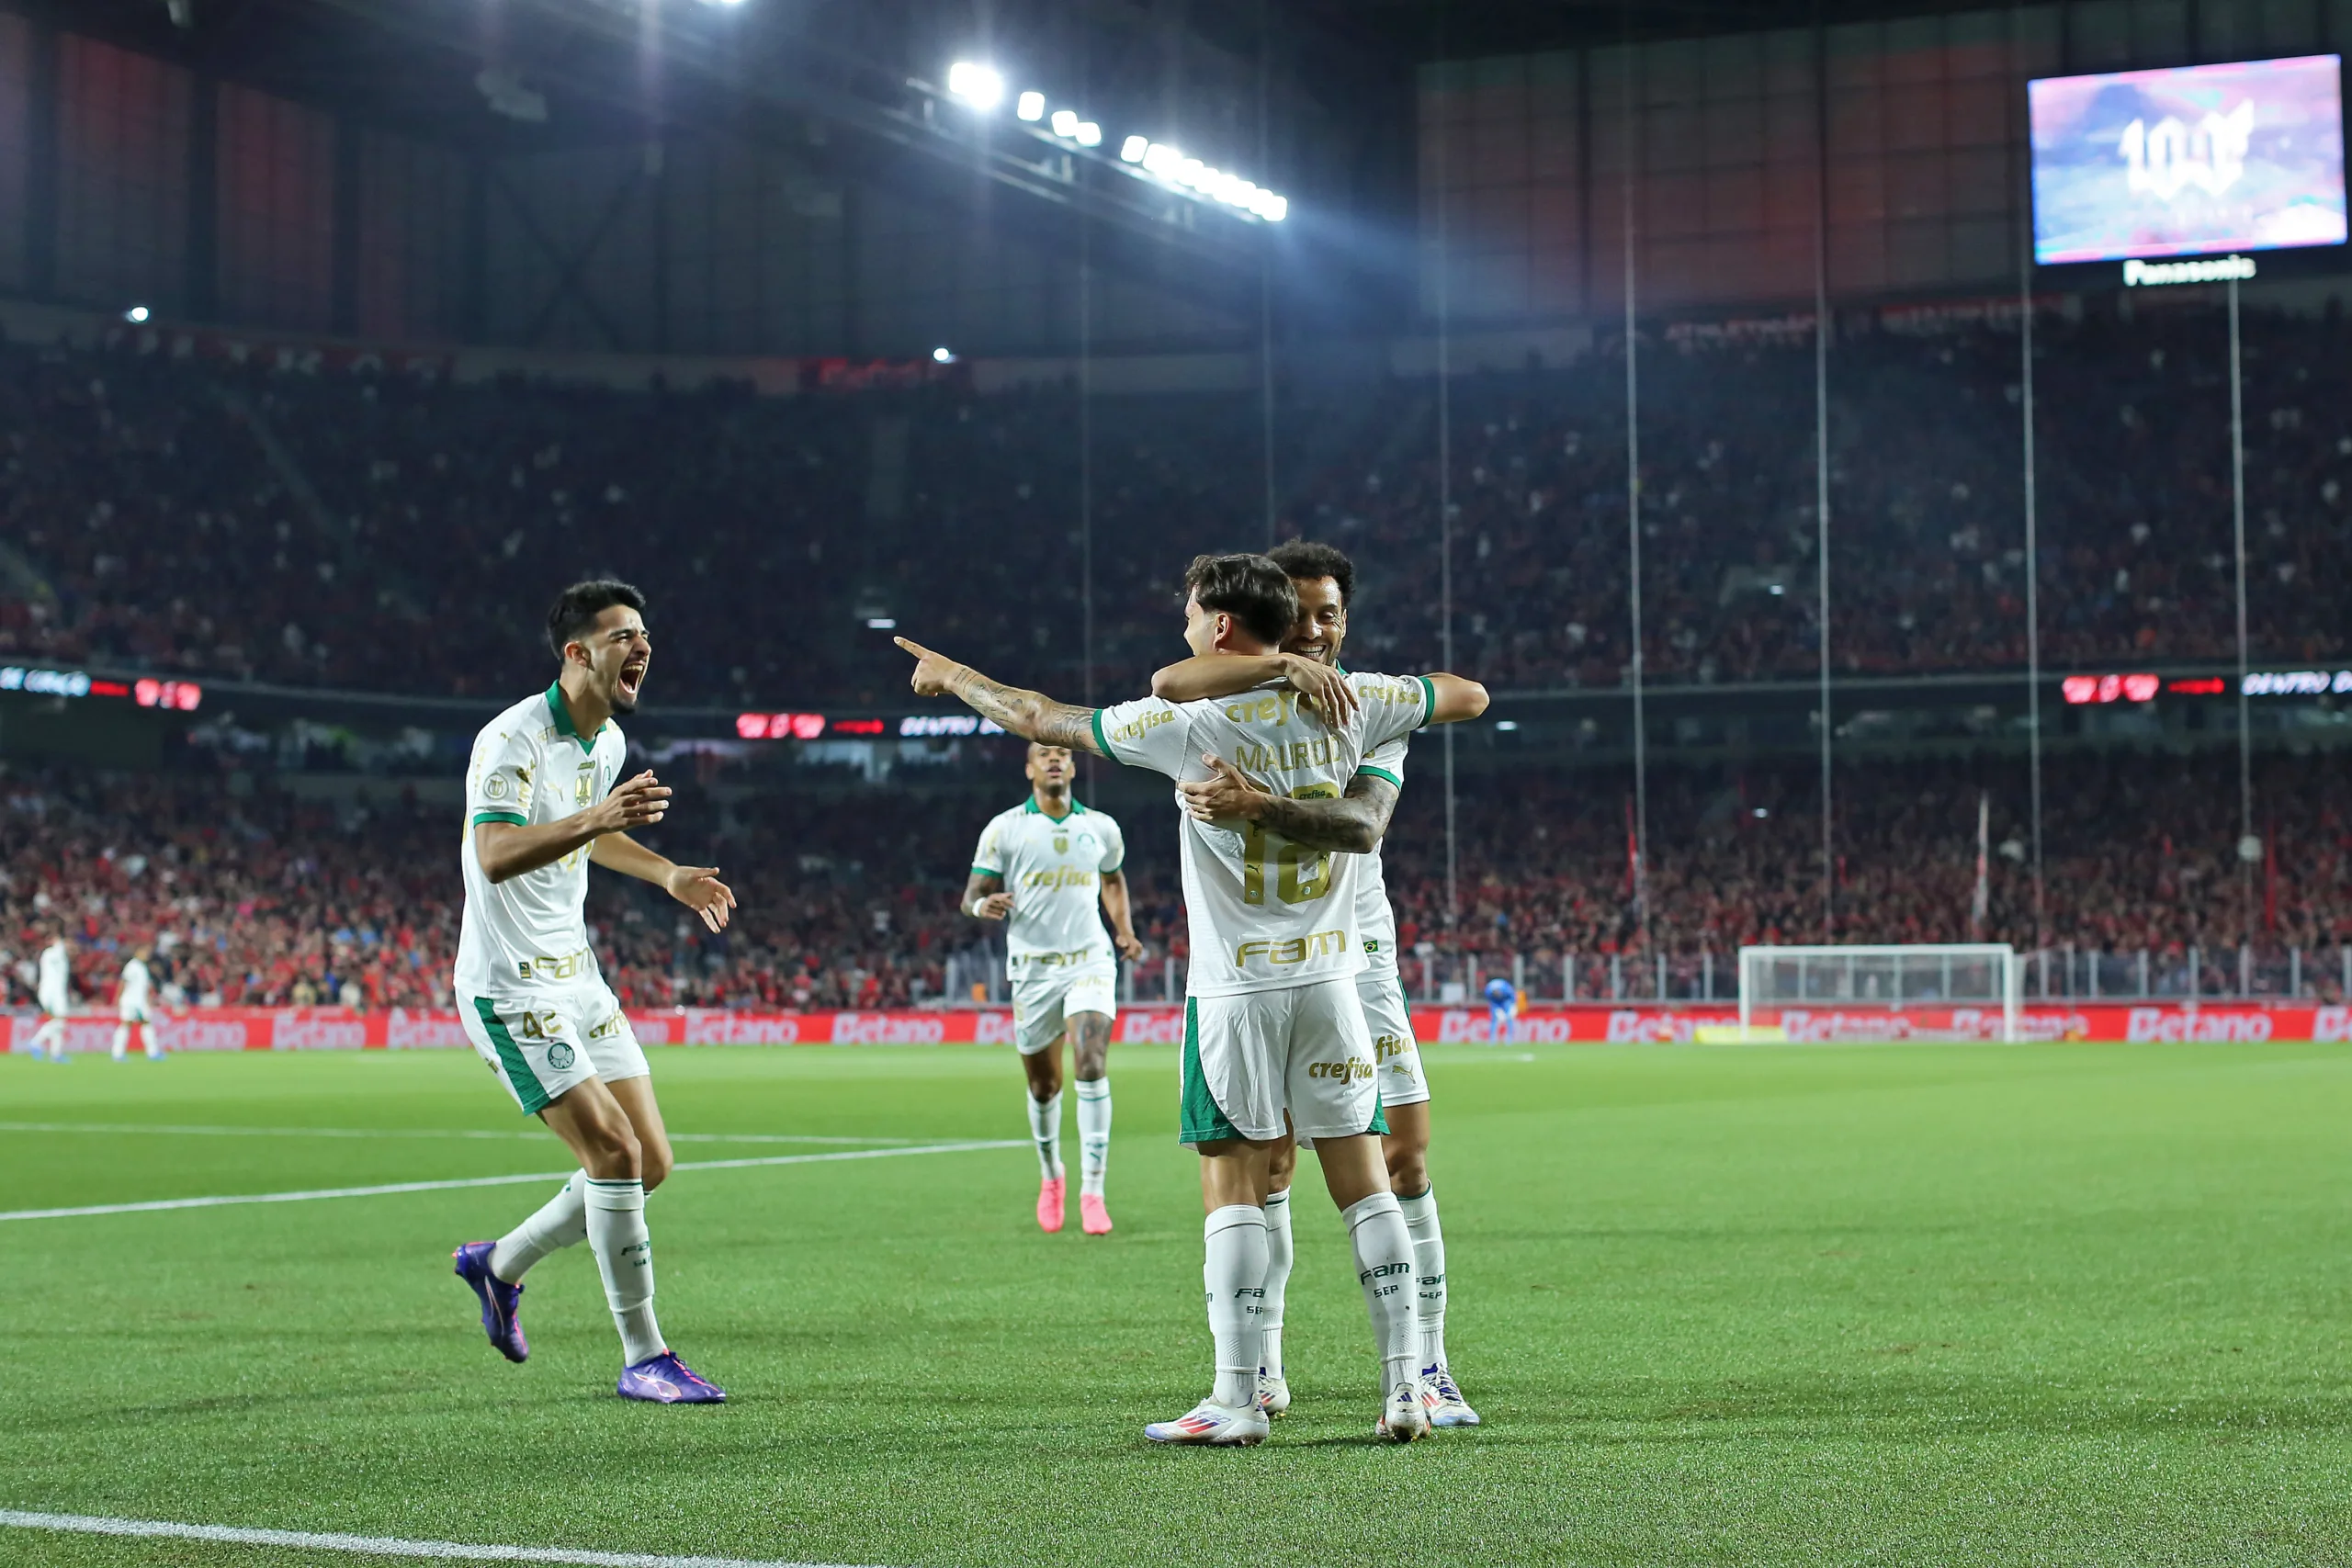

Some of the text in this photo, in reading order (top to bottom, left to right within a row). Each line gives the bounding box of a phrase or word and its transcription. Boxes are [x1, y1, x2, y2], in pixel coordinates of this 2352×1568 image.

[2122, 254, 2257, 287] Panasonic
[1225, 690, 1305, 727] cref
[1359, 685, 1419, 705] crefisa
[1113, 708, 1175, 742] crefisa
[1023, 864, 1092, 892] crefisa
[522, 1009, 562, 1040] 42
[684, 1010, 798, 1046] Betano
[831, 1012, 944, 1044] Betano
[2127, 1008, 2273, 1043] Betano
[1375, 1034, 1413, 1065] fisa
[1308, 1056, 1374, 1085] crefisa
[1374, 1284, 1399, 1299] SEP
[1419, 1291, 1442, 1300] SEP
